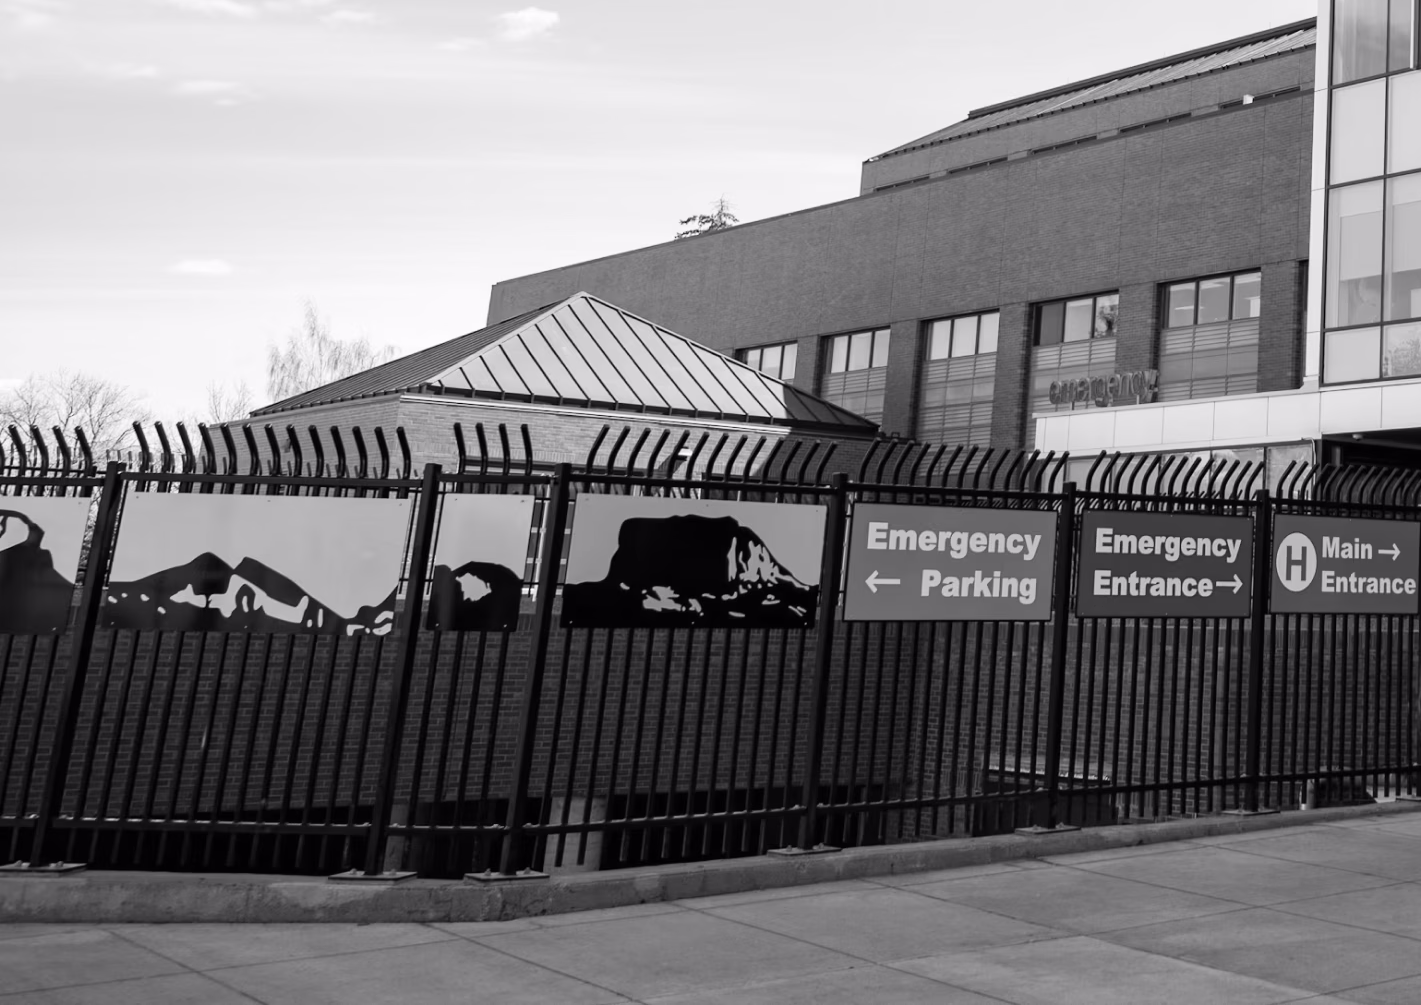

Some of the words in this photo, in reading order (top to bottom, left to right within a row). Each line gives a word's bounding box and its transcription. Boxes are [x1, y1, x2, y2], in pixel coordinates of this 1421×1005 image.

[1049, 370, 1155, 408] emergency
[866, 521, 1042, 560] Emergency
[1094, 527, 1242, 563] Emergency
[1320, 536, 1374, 560] Main
[1285, 545, 1309, 583] H
[921, 569, 1038, 605] Parking
[1093, 569, 1214, 598] Entrance
[1320, 570, 1418, 596] Entrance
